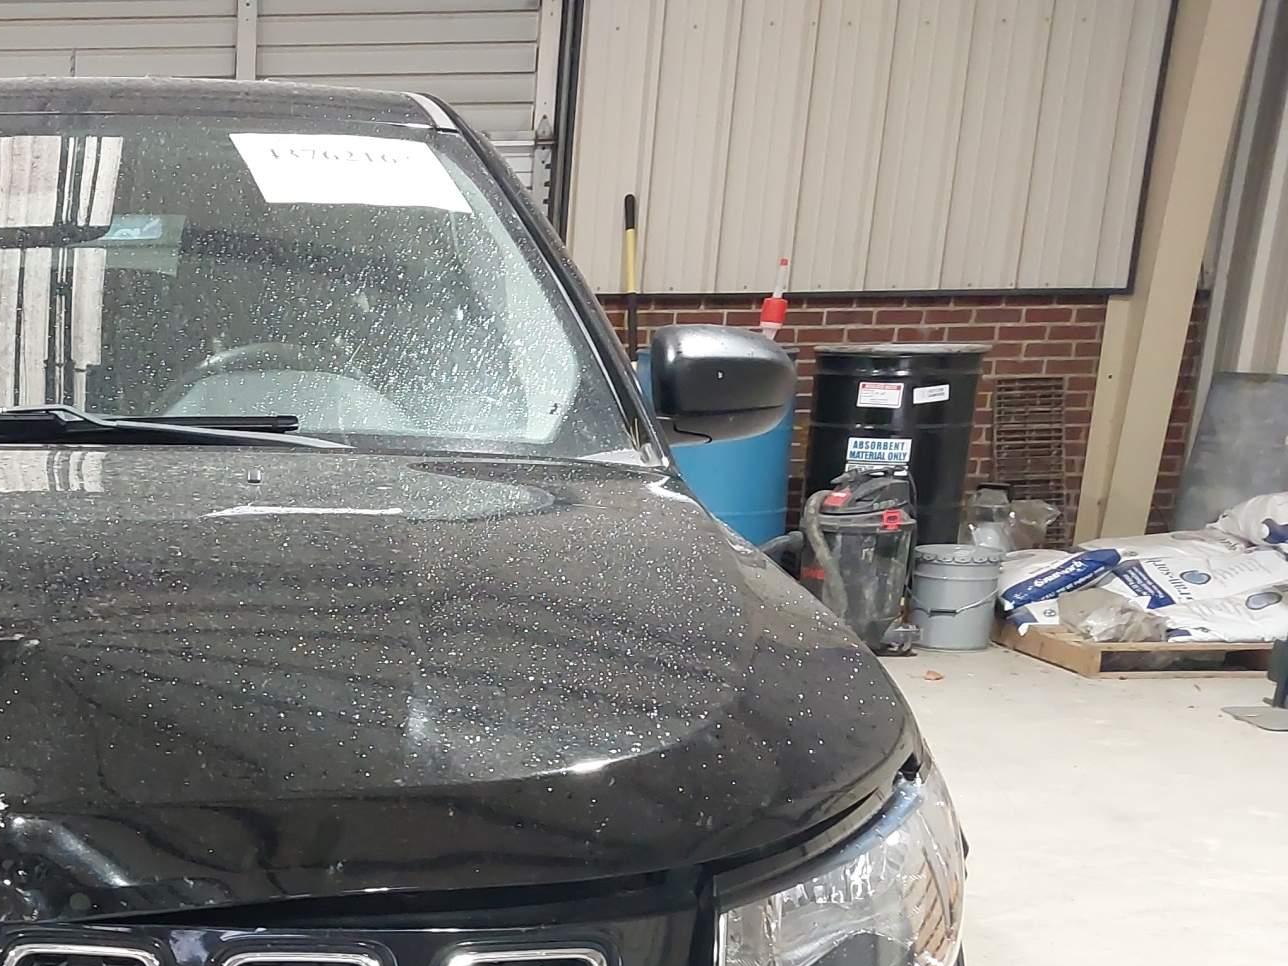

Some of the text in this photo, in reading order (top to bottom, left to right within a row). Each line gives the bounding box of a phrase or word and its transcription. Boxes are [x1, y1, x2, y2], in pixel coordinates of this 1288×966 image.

[853, 440, 905, 450] ABSORBENT
[849, 450, 907, 461] MATERIAL ONLY
